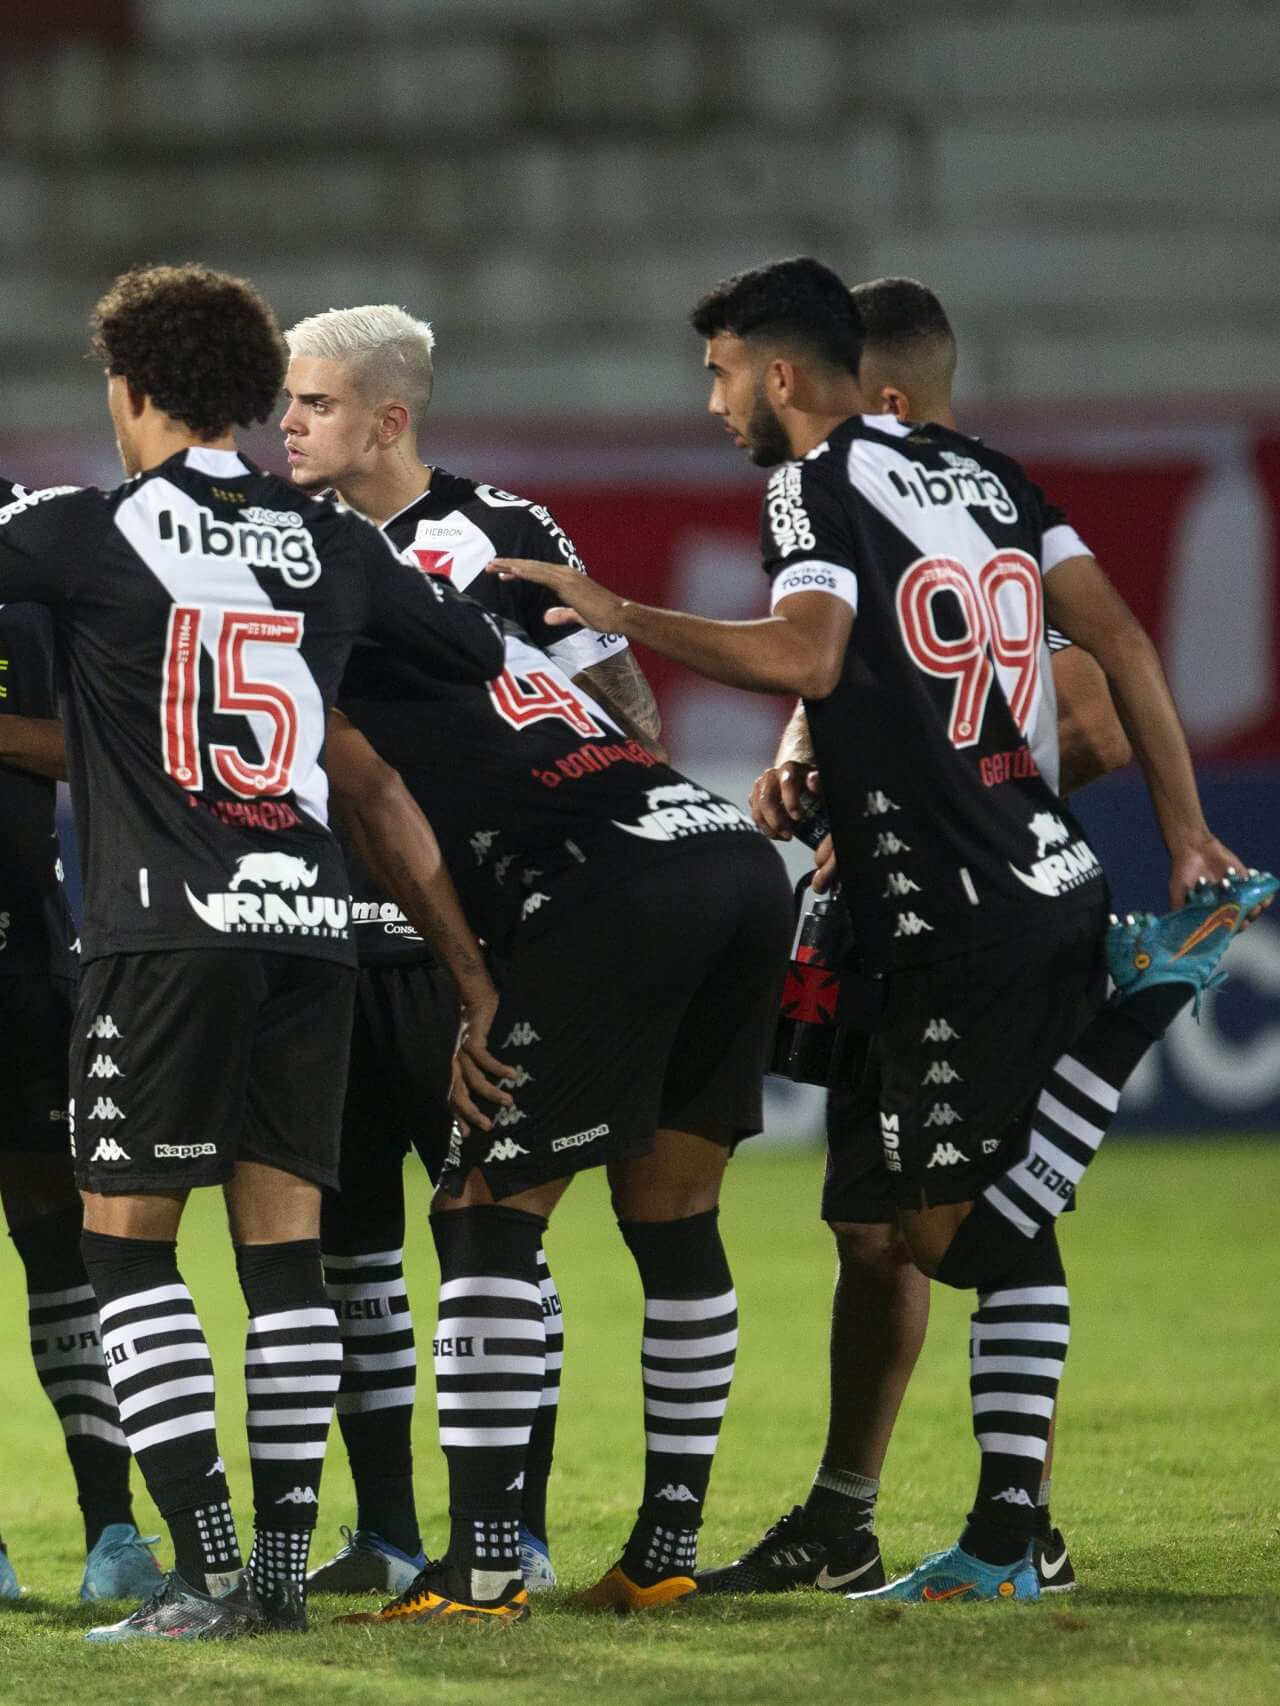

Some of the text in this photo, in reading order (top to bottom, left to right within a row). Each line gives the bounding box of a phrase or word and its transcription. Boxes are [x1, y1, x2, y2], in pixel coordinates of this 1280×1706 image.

[240, 508, 303, 528] VASCO
[913, 461, 1019, 524] bmg
[199, 509, 321, 588] bmg
[896, 548, 1045, 749] 99
[161, 604, 304, 799] 15
[485, 665, 607, 738] 4
[224, 923, 349, 940] ENERGY DRINK
[155, 1143, 216, 1158] Kappa
[552, 1123, 610, 1152] Kappa
